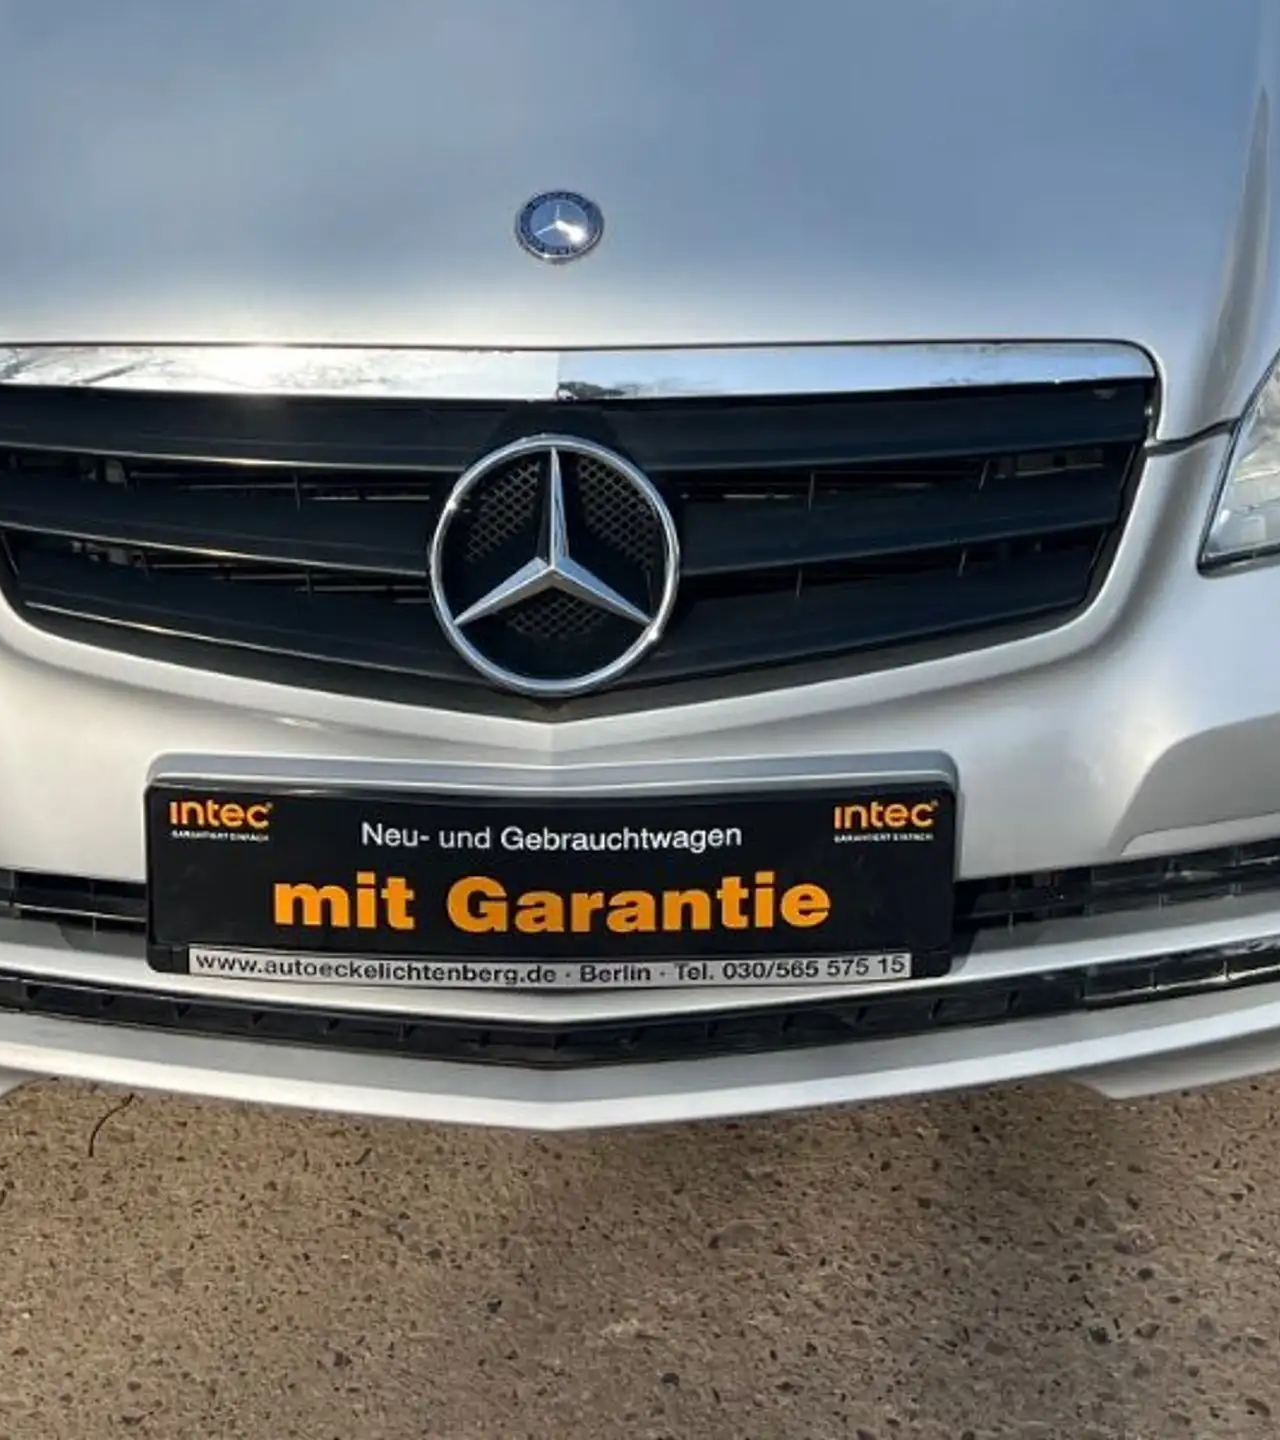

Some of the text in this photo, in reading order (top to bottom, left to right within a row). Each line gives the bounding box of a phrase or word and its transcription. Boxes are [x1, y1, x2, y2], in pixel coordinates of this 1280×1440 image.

[361, 822, 743, 853] Neu- und Gebrauchtwagen
[273, 871, 831, 933] mit Garantie
[195, 953, 906, 984] www.autoeckelichtenberg.de Berlin Tel. 030/565 575 15
